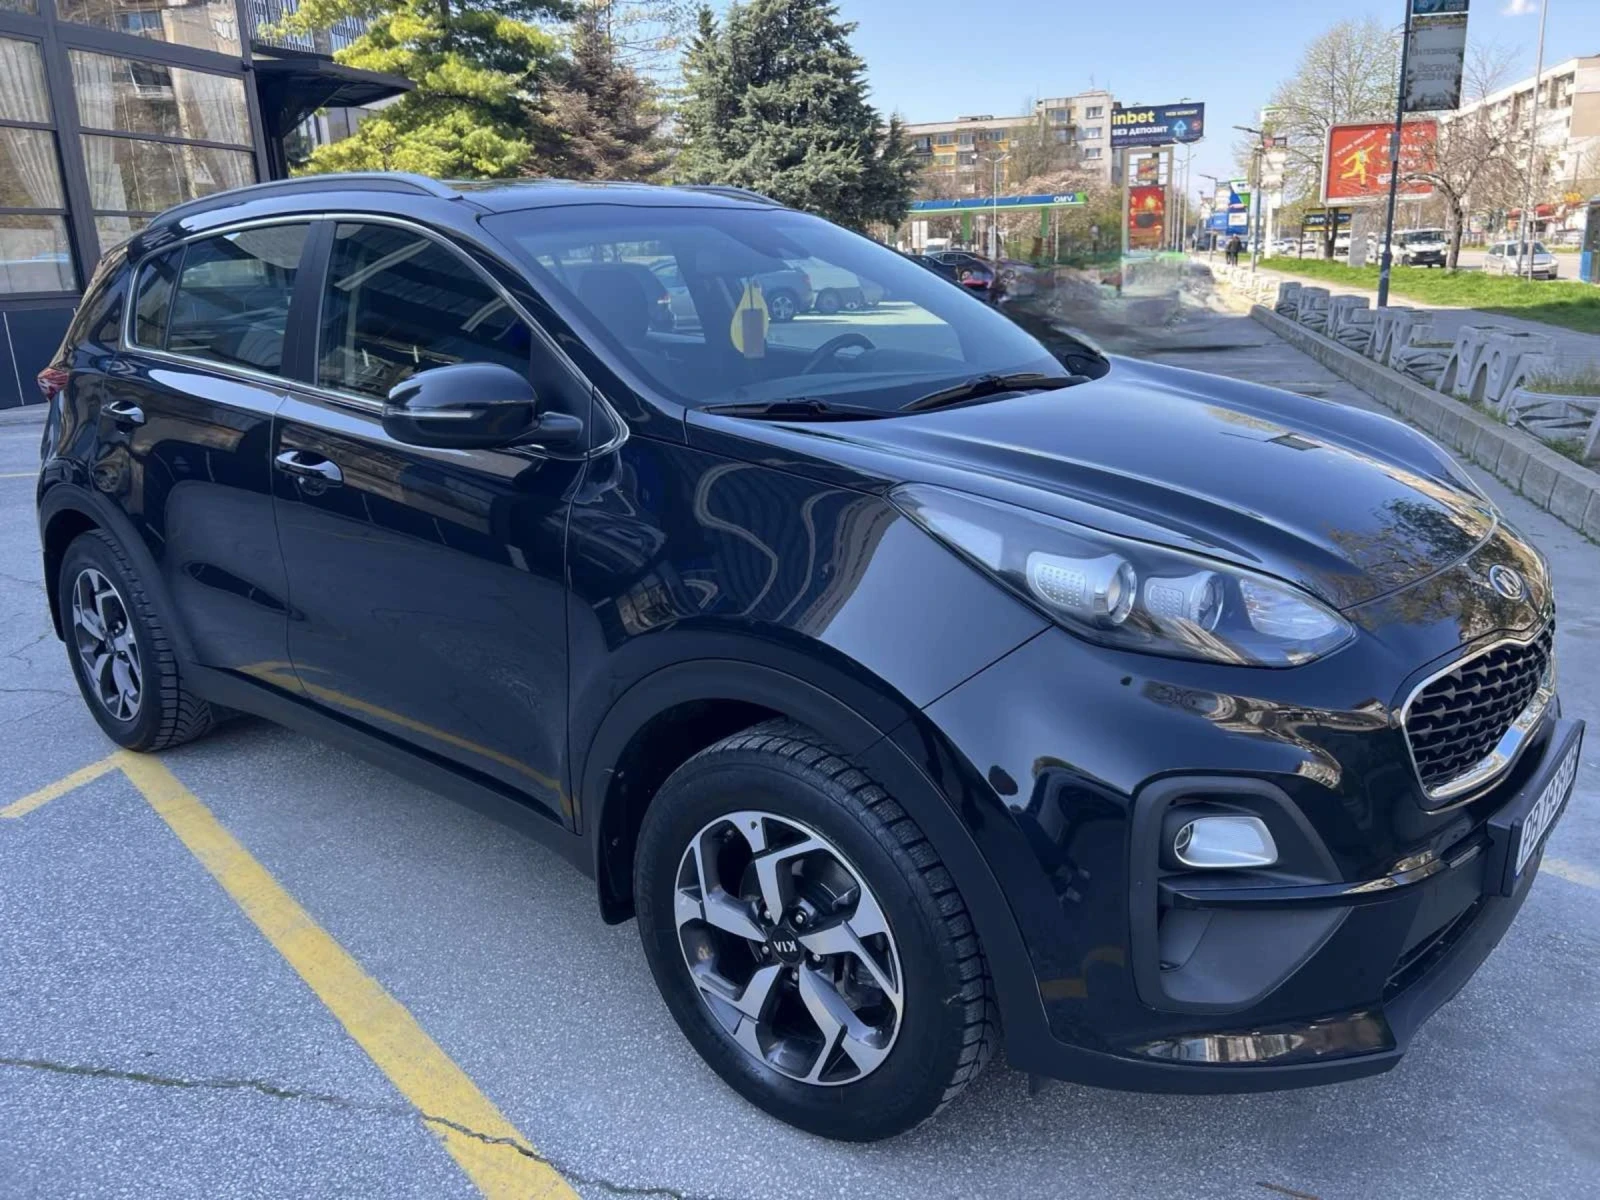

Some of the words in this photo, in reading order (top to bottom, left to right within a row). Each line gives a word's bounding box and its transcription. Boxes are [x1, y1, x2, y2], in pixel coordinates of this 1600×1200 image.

[1112, 110, 1155, 125] inbet
[1053, 195, 1073, 203] OMV
[773, 941, 797, 952] KIA
